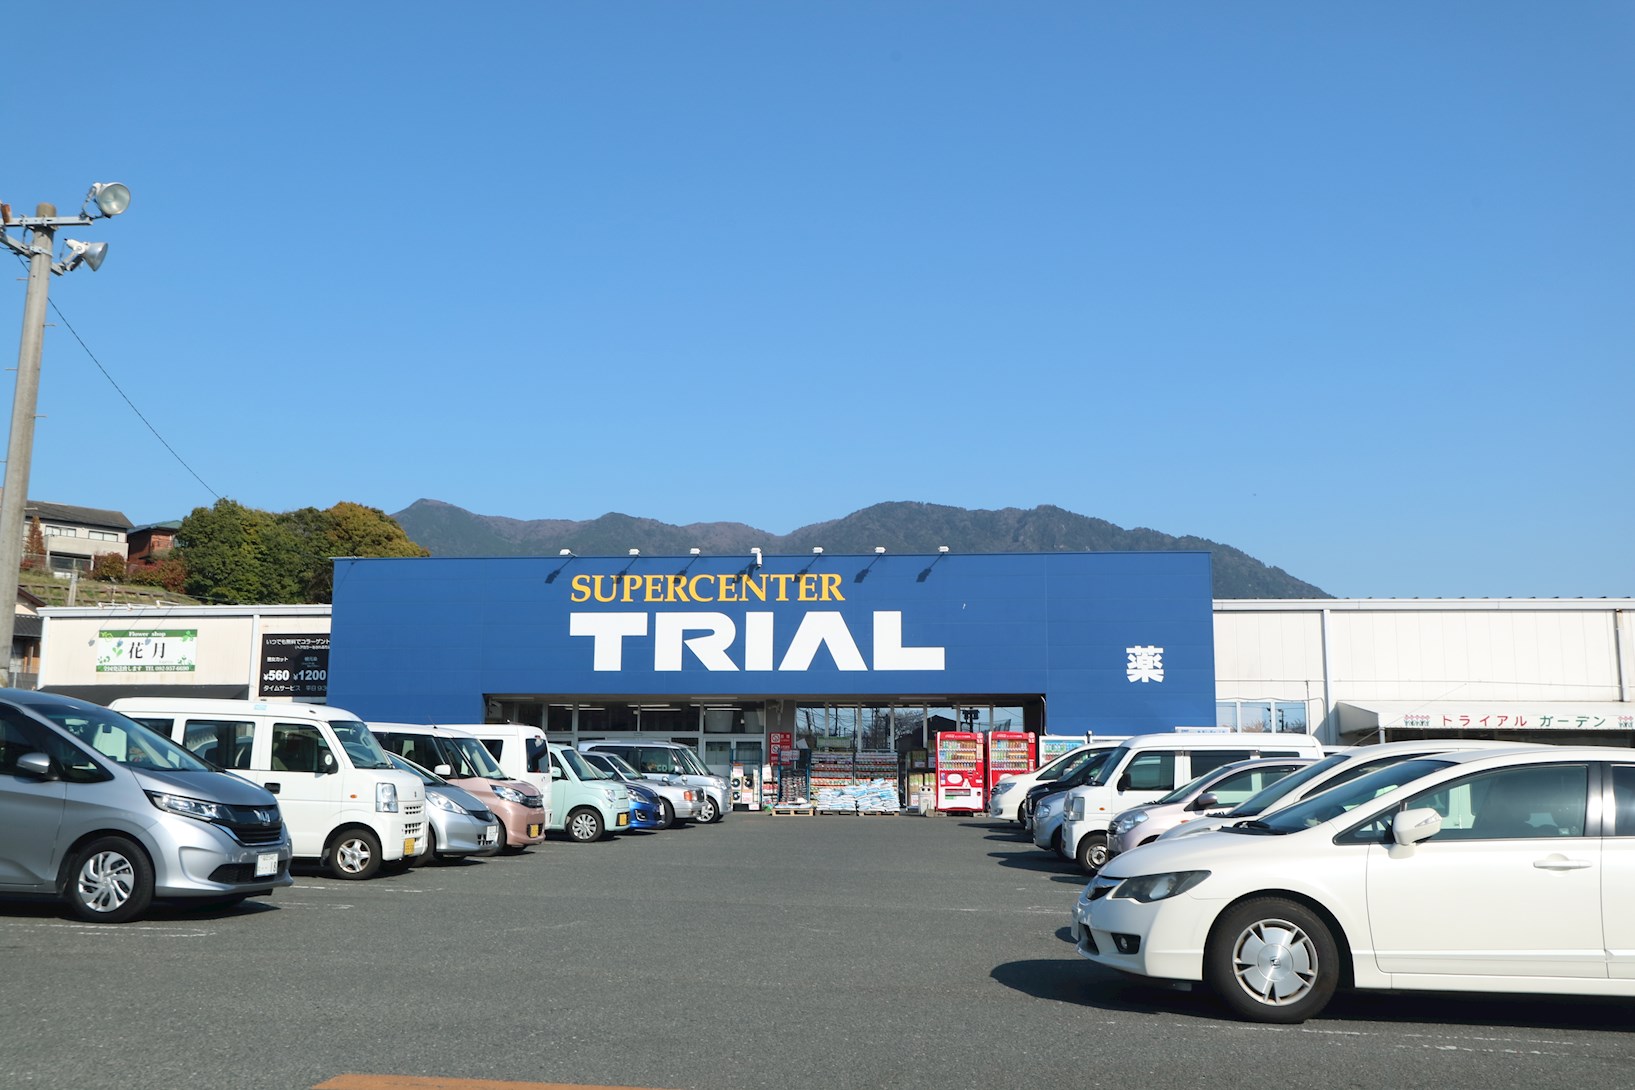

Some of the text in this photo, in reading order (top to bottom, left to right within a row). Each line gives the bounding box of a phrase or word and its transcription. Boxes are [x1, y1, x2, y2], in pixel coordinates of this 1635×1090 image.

[570, 573, 845, 603] SUPERCENTER
[128, 641, 166, 659] 花月
[569, 611, 946, 672] TRIAL
[1126, 646, 1164, 683] 薬
[263, 669, 290, 681] ¥560
[293, 669, 327, 681] ¥1200
[1442, 714, 1607, 728] トライアル ガーデン
